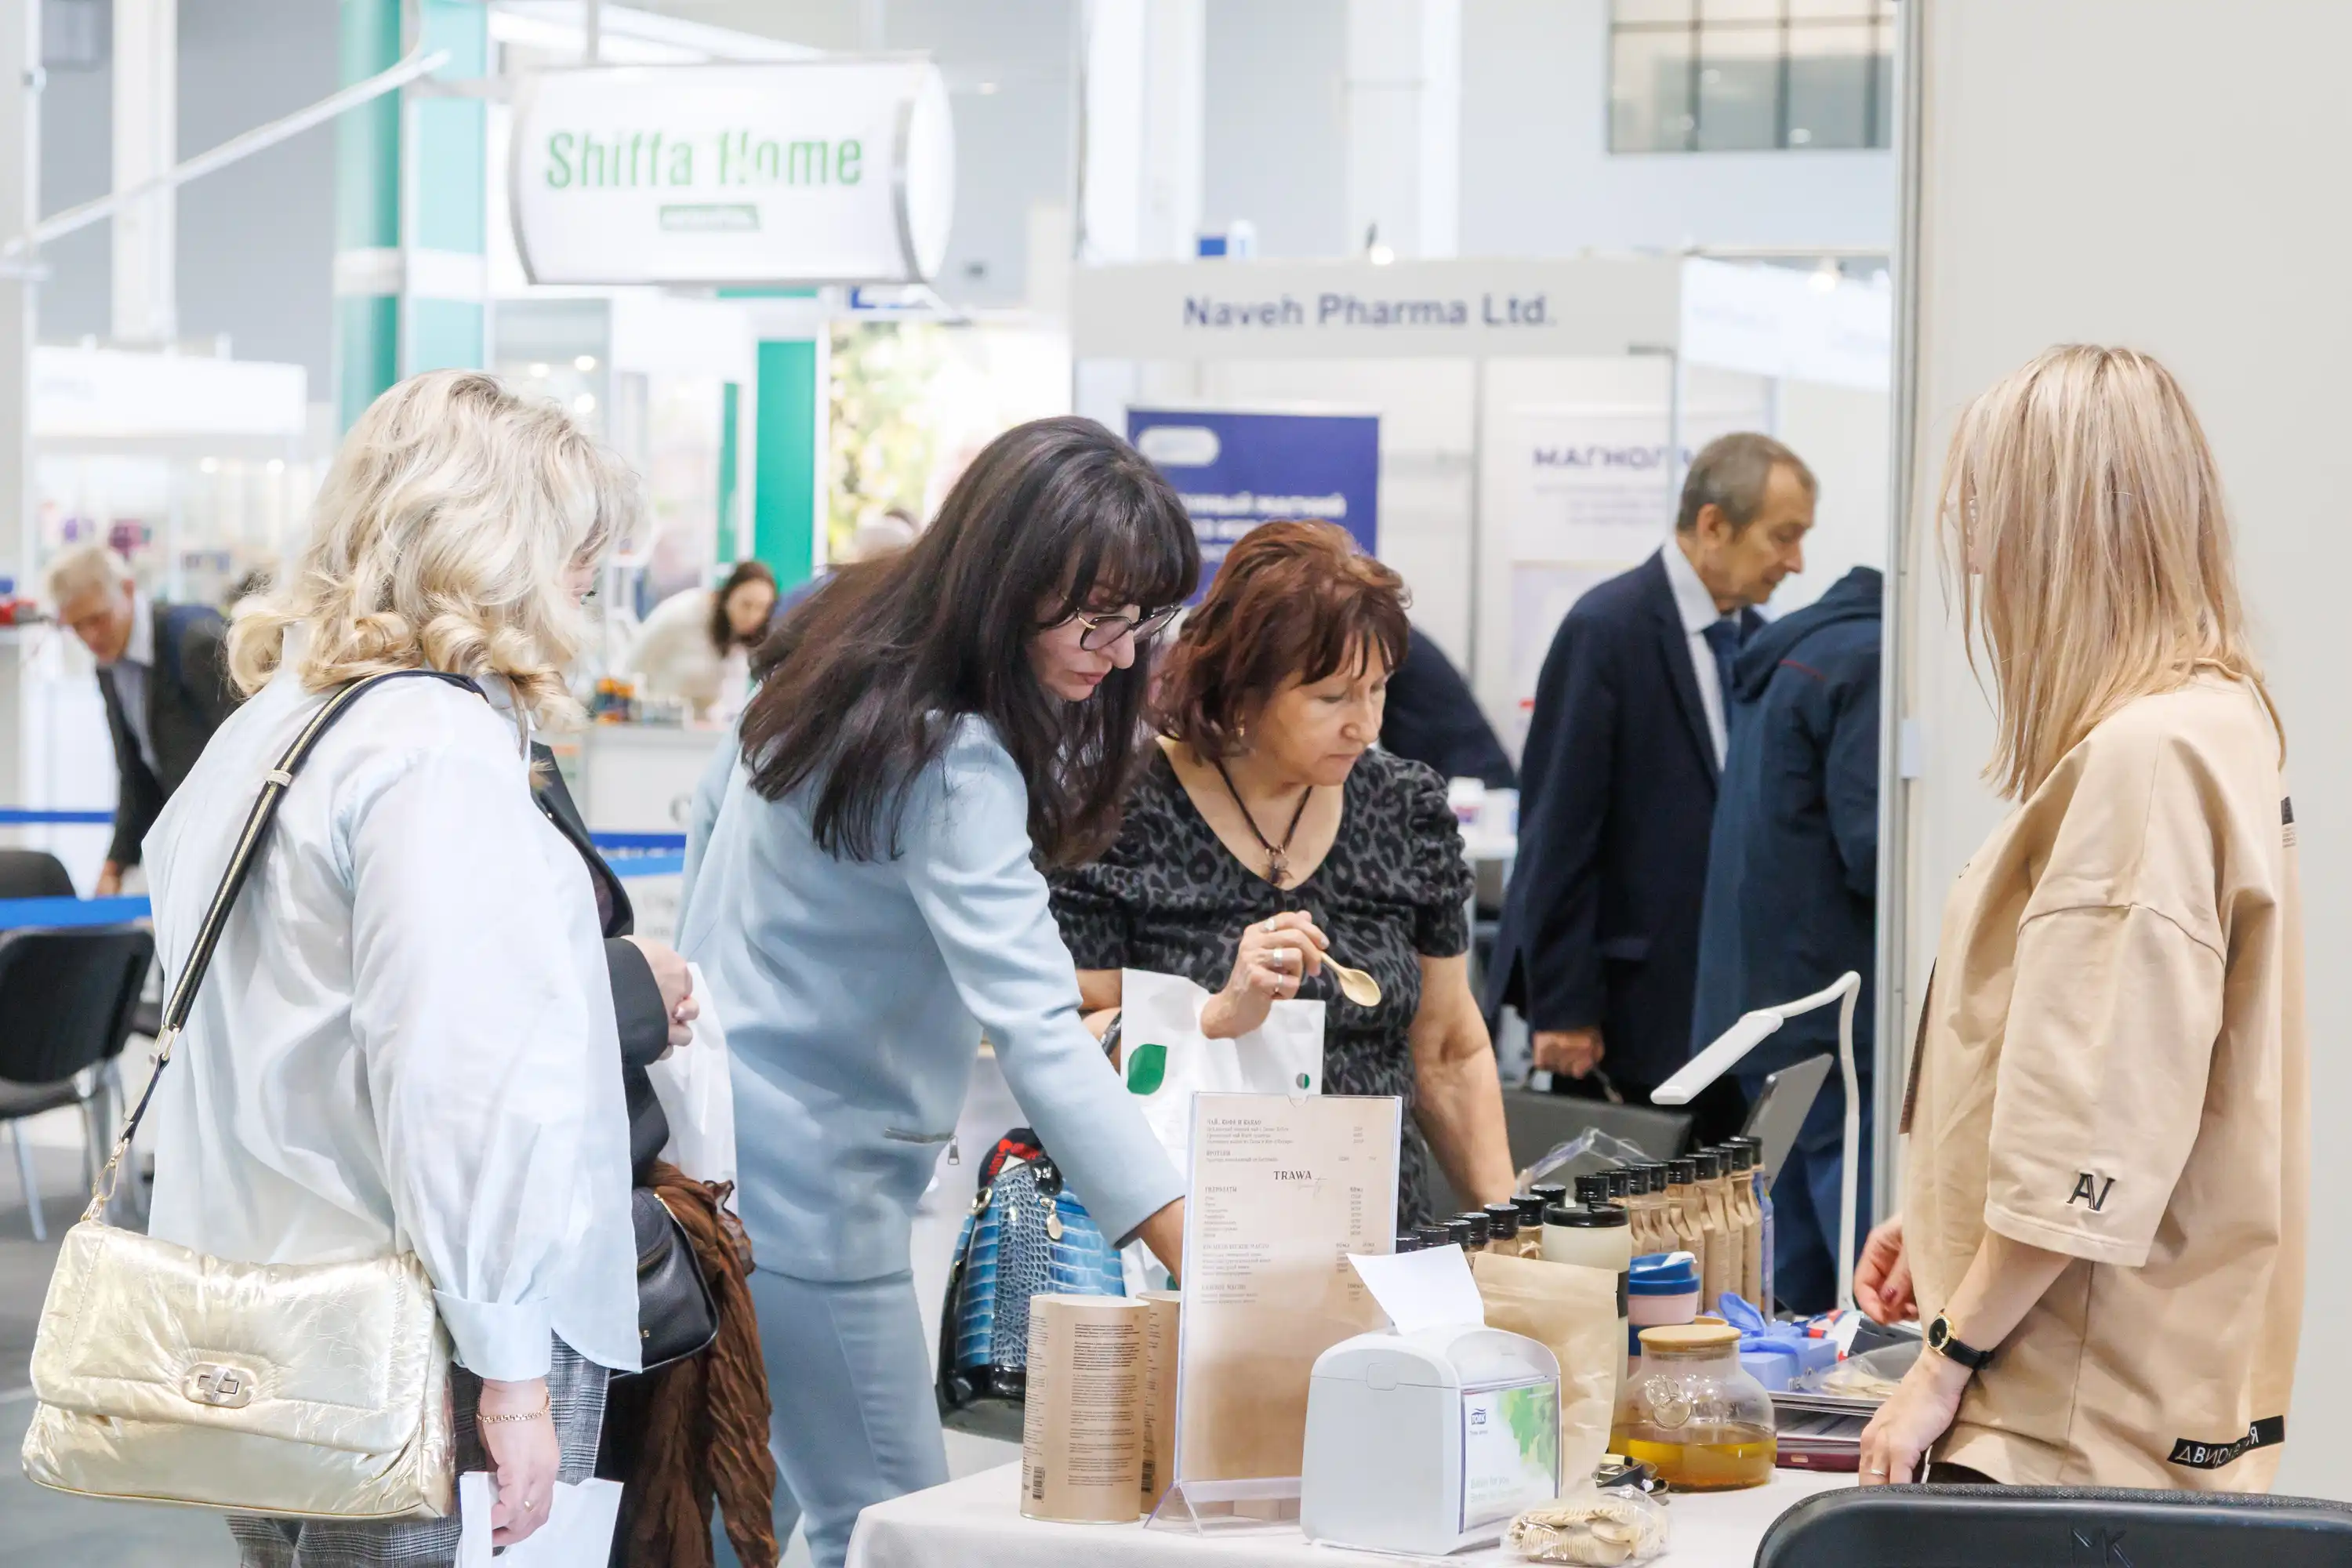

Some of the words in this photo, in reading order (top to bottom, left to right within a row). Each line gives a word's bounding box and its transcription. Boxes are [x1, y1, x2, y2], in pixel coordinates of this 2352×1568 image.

[547, 132, 693, 188] Shiffa
[717, 130, 862, 185] Home
[1183, 295, 1305, 326] Naveh
[1317, 293, 1469, 326] Pharma
[1481, 292, 1557, 327] Ltd.
[1273, 1171, 1312, 1181] TRAWA
[1472, 1414, 1486, 1424] TORK
